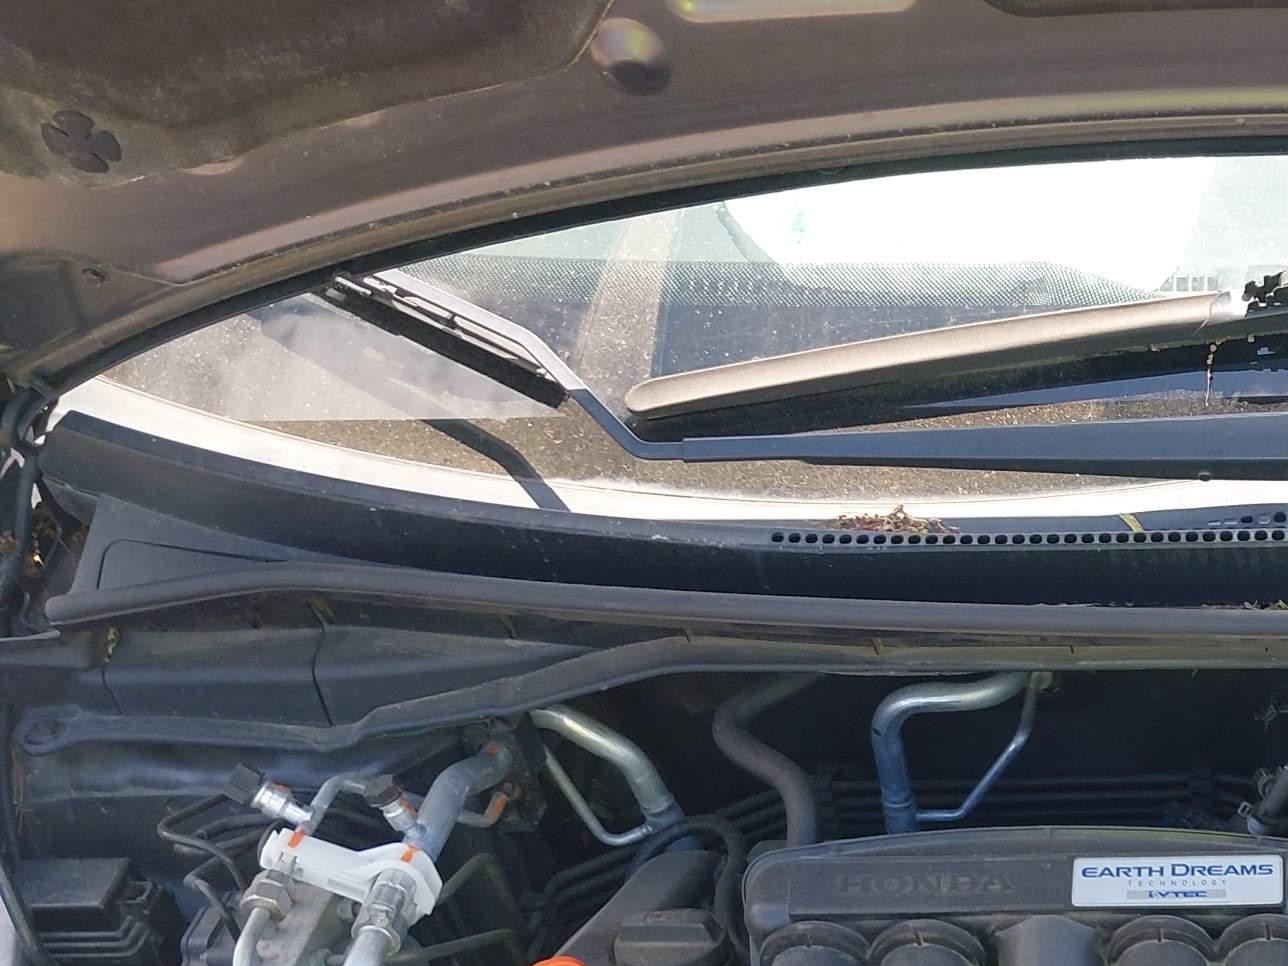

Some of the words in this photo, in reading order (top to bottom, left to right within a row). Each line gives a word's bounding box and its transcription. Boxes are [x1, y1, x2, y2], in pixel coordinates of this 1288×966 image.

[1081, 866, 1164, 878] EARTH
[1171, 863, 1274, 876] DREAMS
[838, 874, 1017, 894] HONDA
[1127, 879, 1227, 888] TECHNOLOGY
